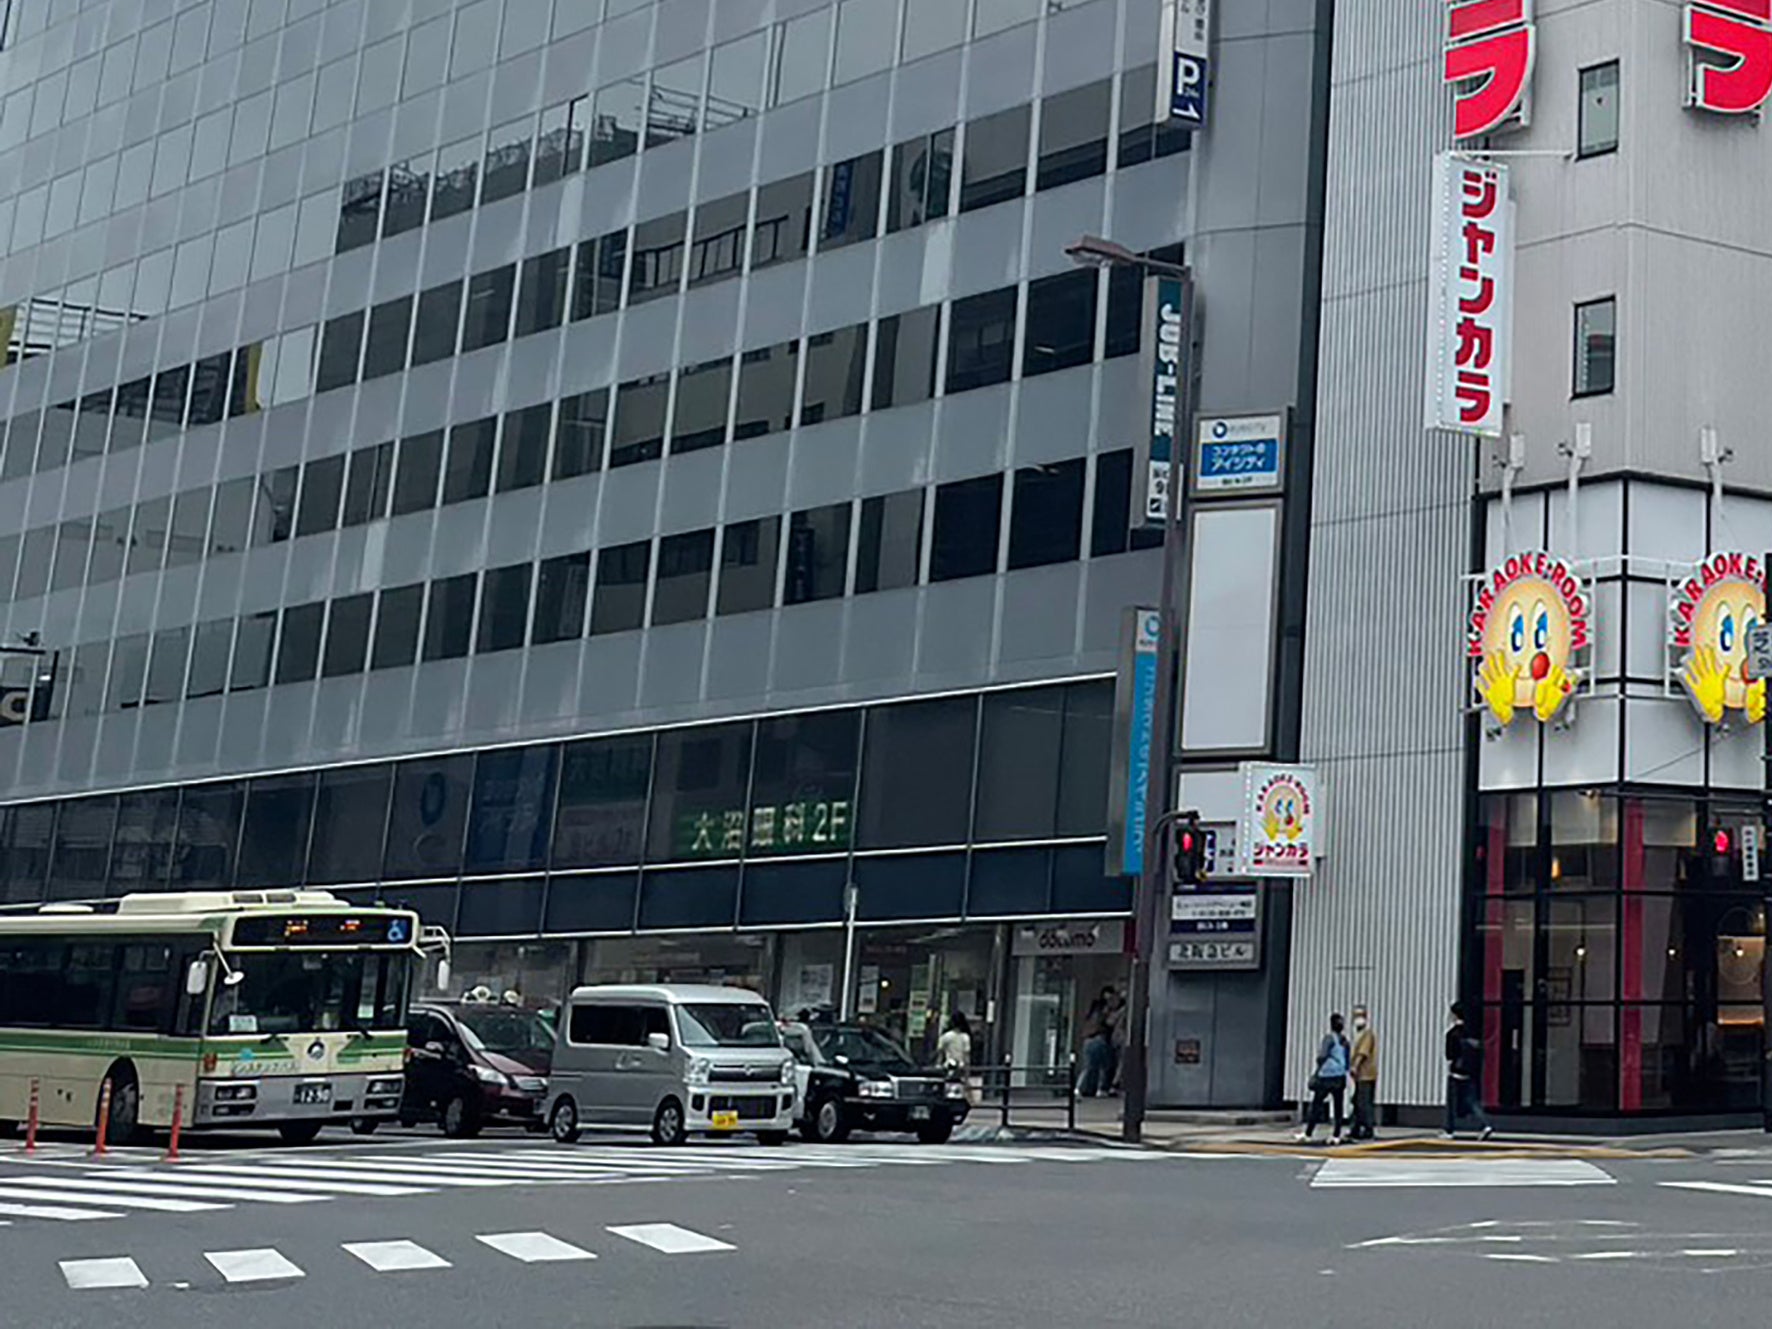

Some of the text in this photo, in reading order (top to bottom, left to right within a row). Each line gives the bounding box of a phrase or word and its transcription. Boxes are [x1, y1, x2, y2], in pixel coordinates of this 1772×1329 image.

[1455, 169, 1498, 423] ジャンカラ
